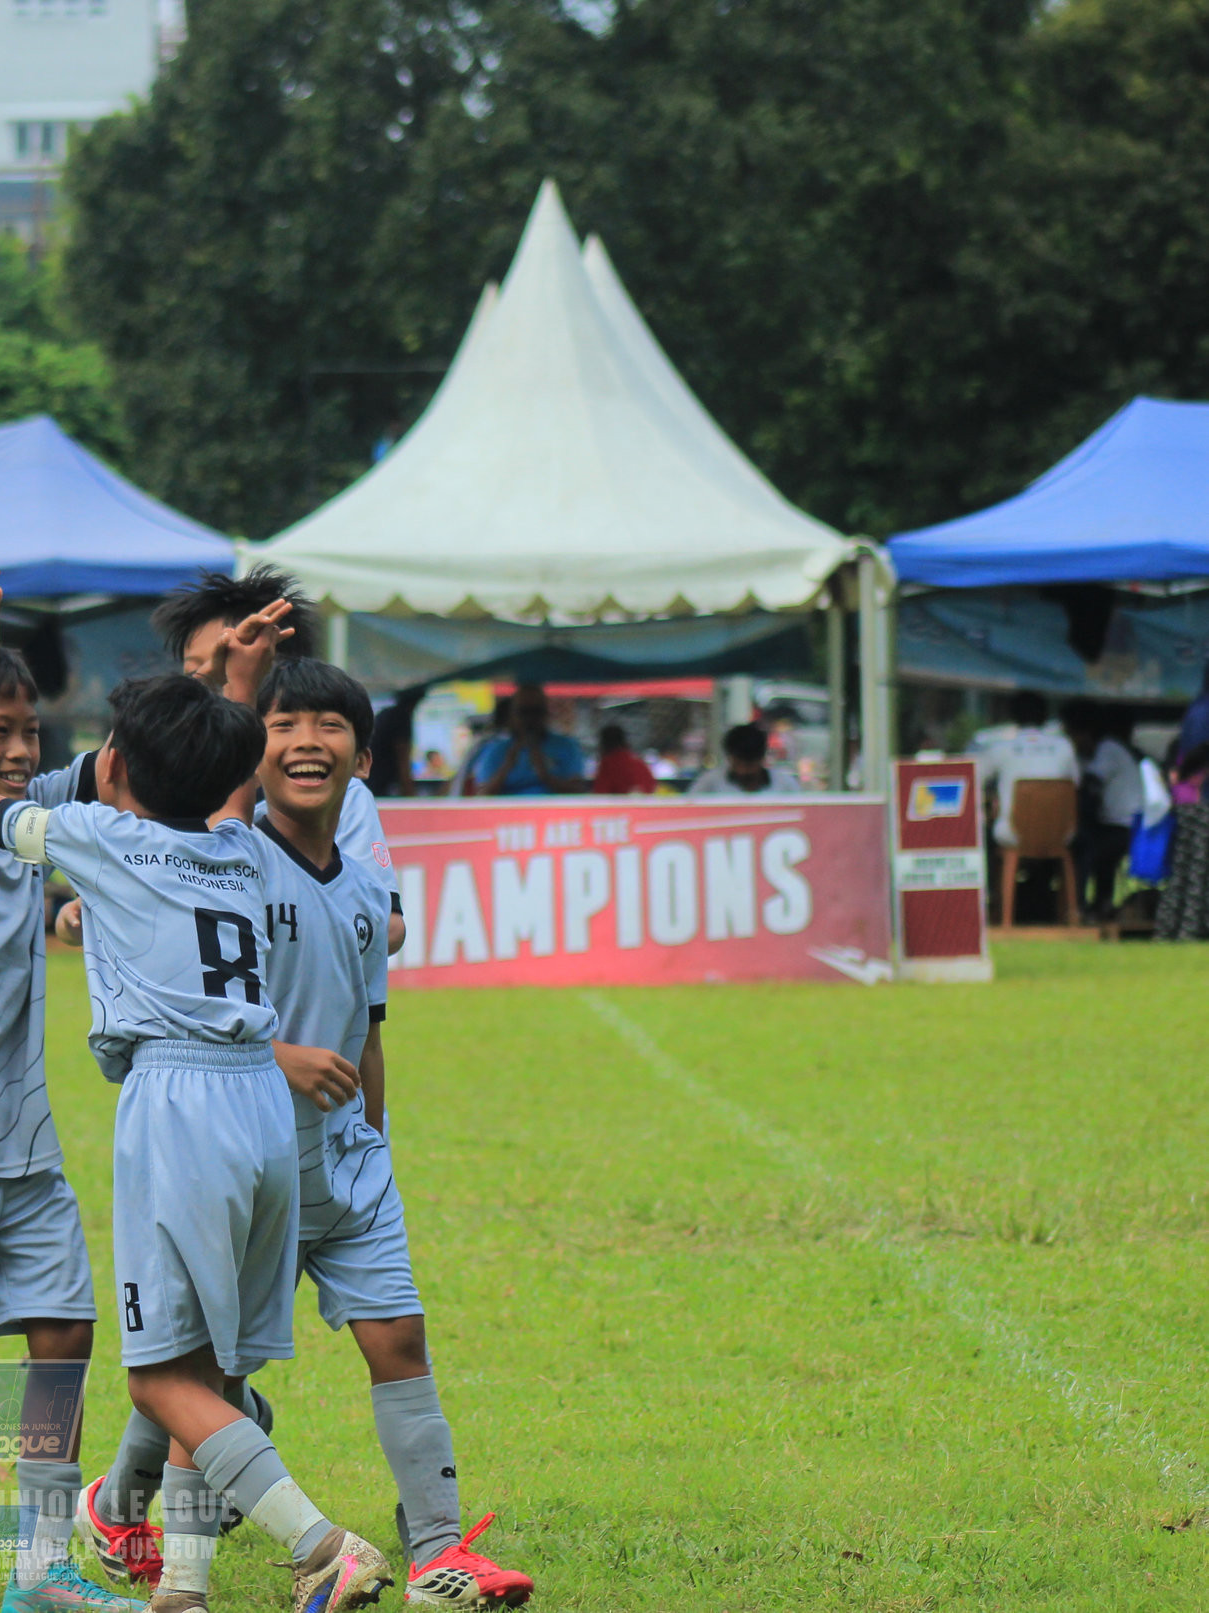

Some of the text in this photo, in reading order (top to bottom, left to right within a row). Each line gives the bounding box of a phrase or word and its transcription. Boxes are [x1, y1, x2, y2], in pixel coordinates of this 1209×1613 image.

[590, 815, 629, 845] THE
[124, 854, 160, 866] ASIA
[165, 855, 232, 877] FOOTBALL
[178, 873, 249, 894] INDONESIA
[265, 902, 298, 943] 14
[194, 906, 261, 1006] 8
[123, 1282, 144, 1332] 8
